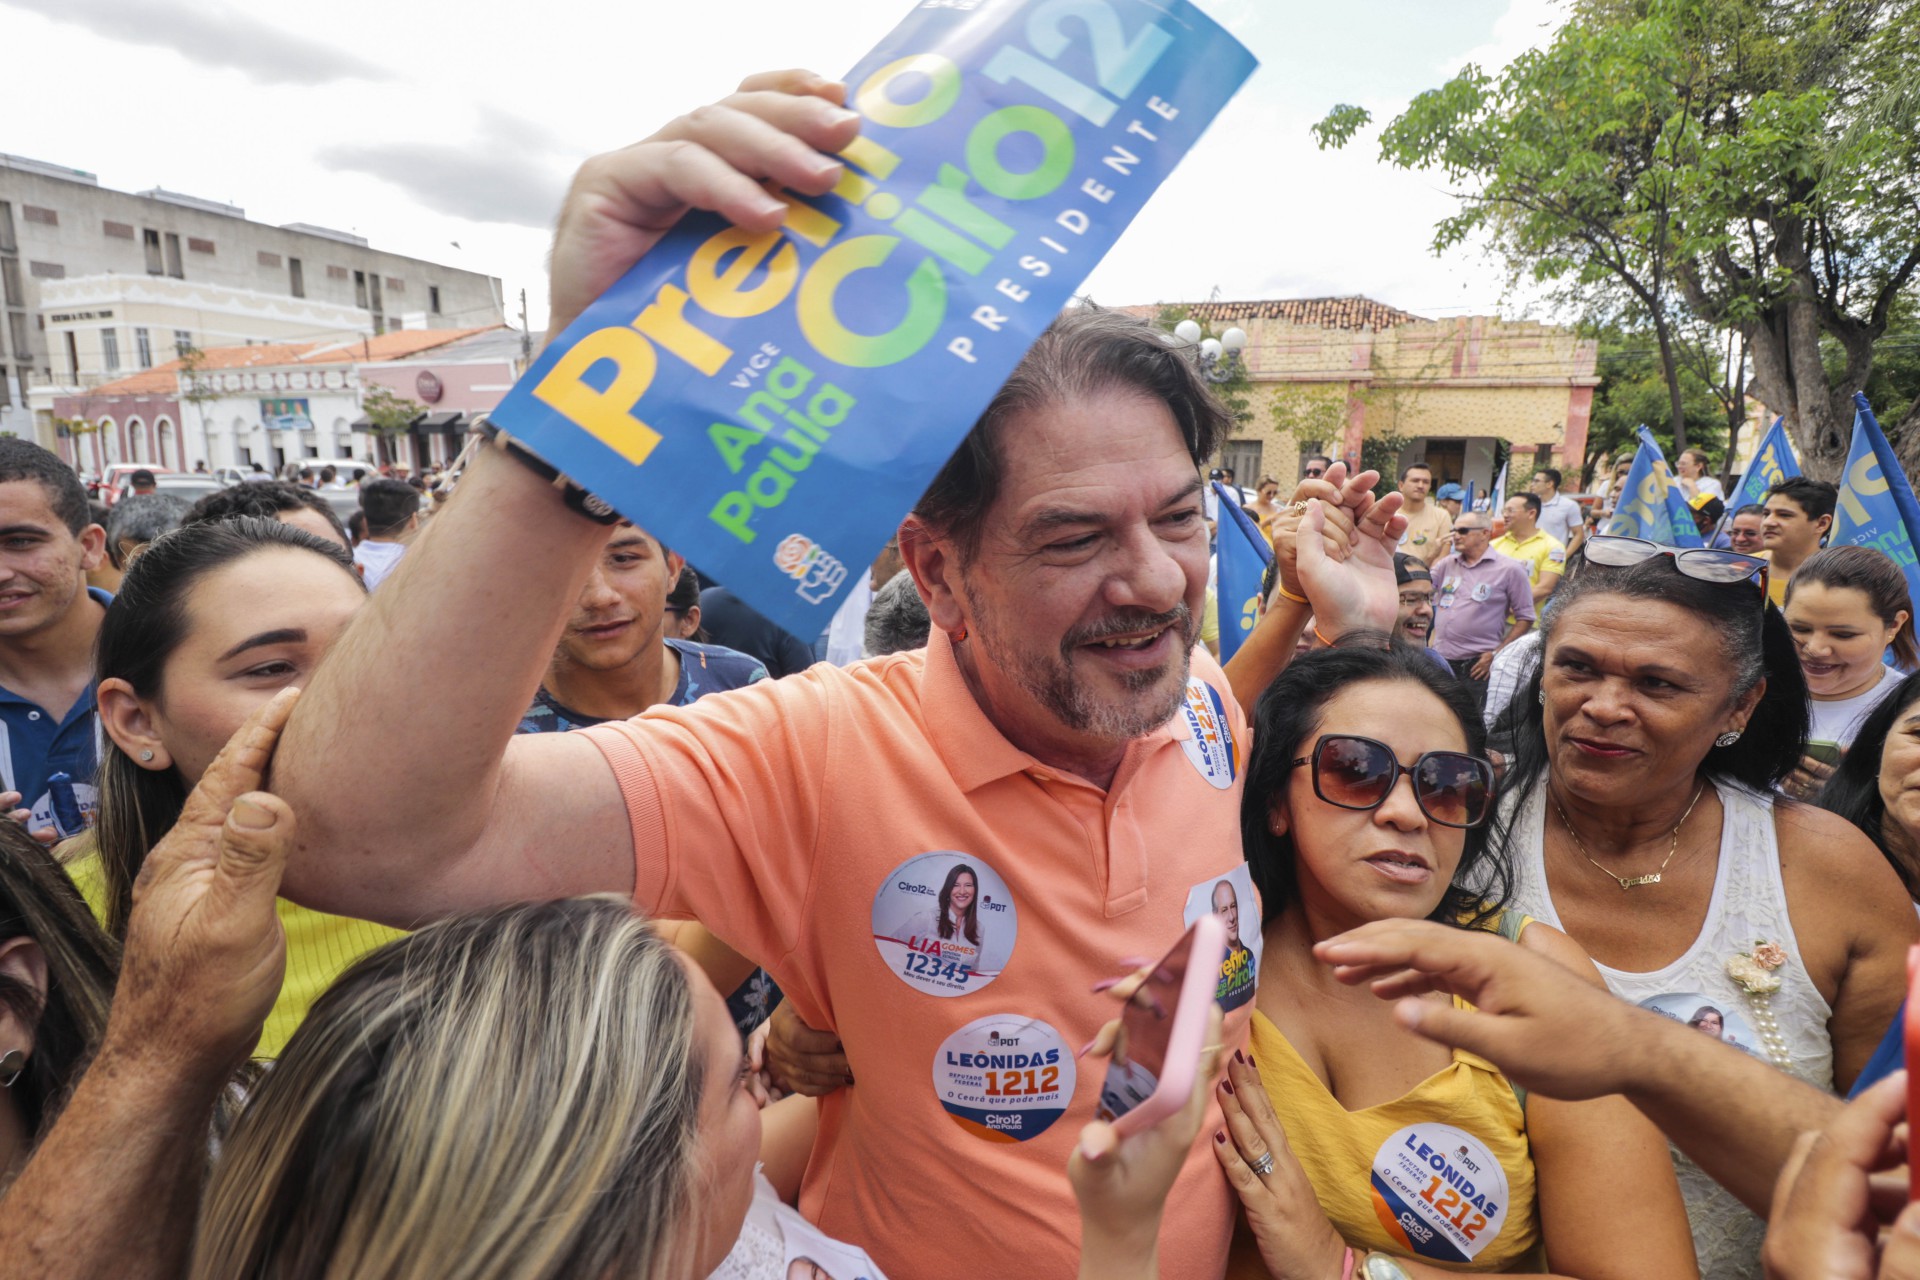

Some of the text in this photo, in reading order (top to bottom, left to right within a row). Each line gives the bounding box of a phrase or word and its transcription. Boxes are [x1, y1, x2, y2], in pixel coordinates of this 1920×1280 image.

[947, 95, 1178, 363] PRESIDENTE
[729, 342, 781, 388] VICE
[706, 355, 816, 475] Ana
[707, 383, 858, 545] Paula
[1186, 686, 1218, 744] 1212
[1182, 700, 1215, 776] LEÔNIDA
[898, 881, 926, 894] Ciro12
[990, 903, 1006, 912] PDT
[908, 935, 975, 957] LIA GOMES
[903, 970, 914, 978] Meu
[916, 974, 931, 982] dever
[906, 952, 971, 983] 12345
[1000, 1038, 1020, 1046] PDT
[947, 1048, 1059, 1069] LEÔNIDAS
[949, 1072, 982, 1080] DEPUTADO
[954, 1079, 982, 1087] FEDERAL
[985, 1066, 1059, 1096] 1212
[958, 1092, 986, 1102] Ceará
[1009, 1096, 1034, 1104] pode
[1036, 1093, 1059, 1102] mais
[985, 1114, 1022, 1124] Ciro12
[1398, 1152, 1428, 1179] DEPUTADO
[1399, 1162, 1423, 1184] FEDERAL
[1405, 1133, 1499, 1218] LEÔNIDAS
[1462, 1157, 1481, 1174] PDT
[1383, 1168, 1471, 1247] O Ceará que pode mais
[1419, 1175, 1487, 1241] 1212
[1396, 1219, 1428, 1244] Ana Paula
[1400, 1211, 1434, 1242] Ciro12
